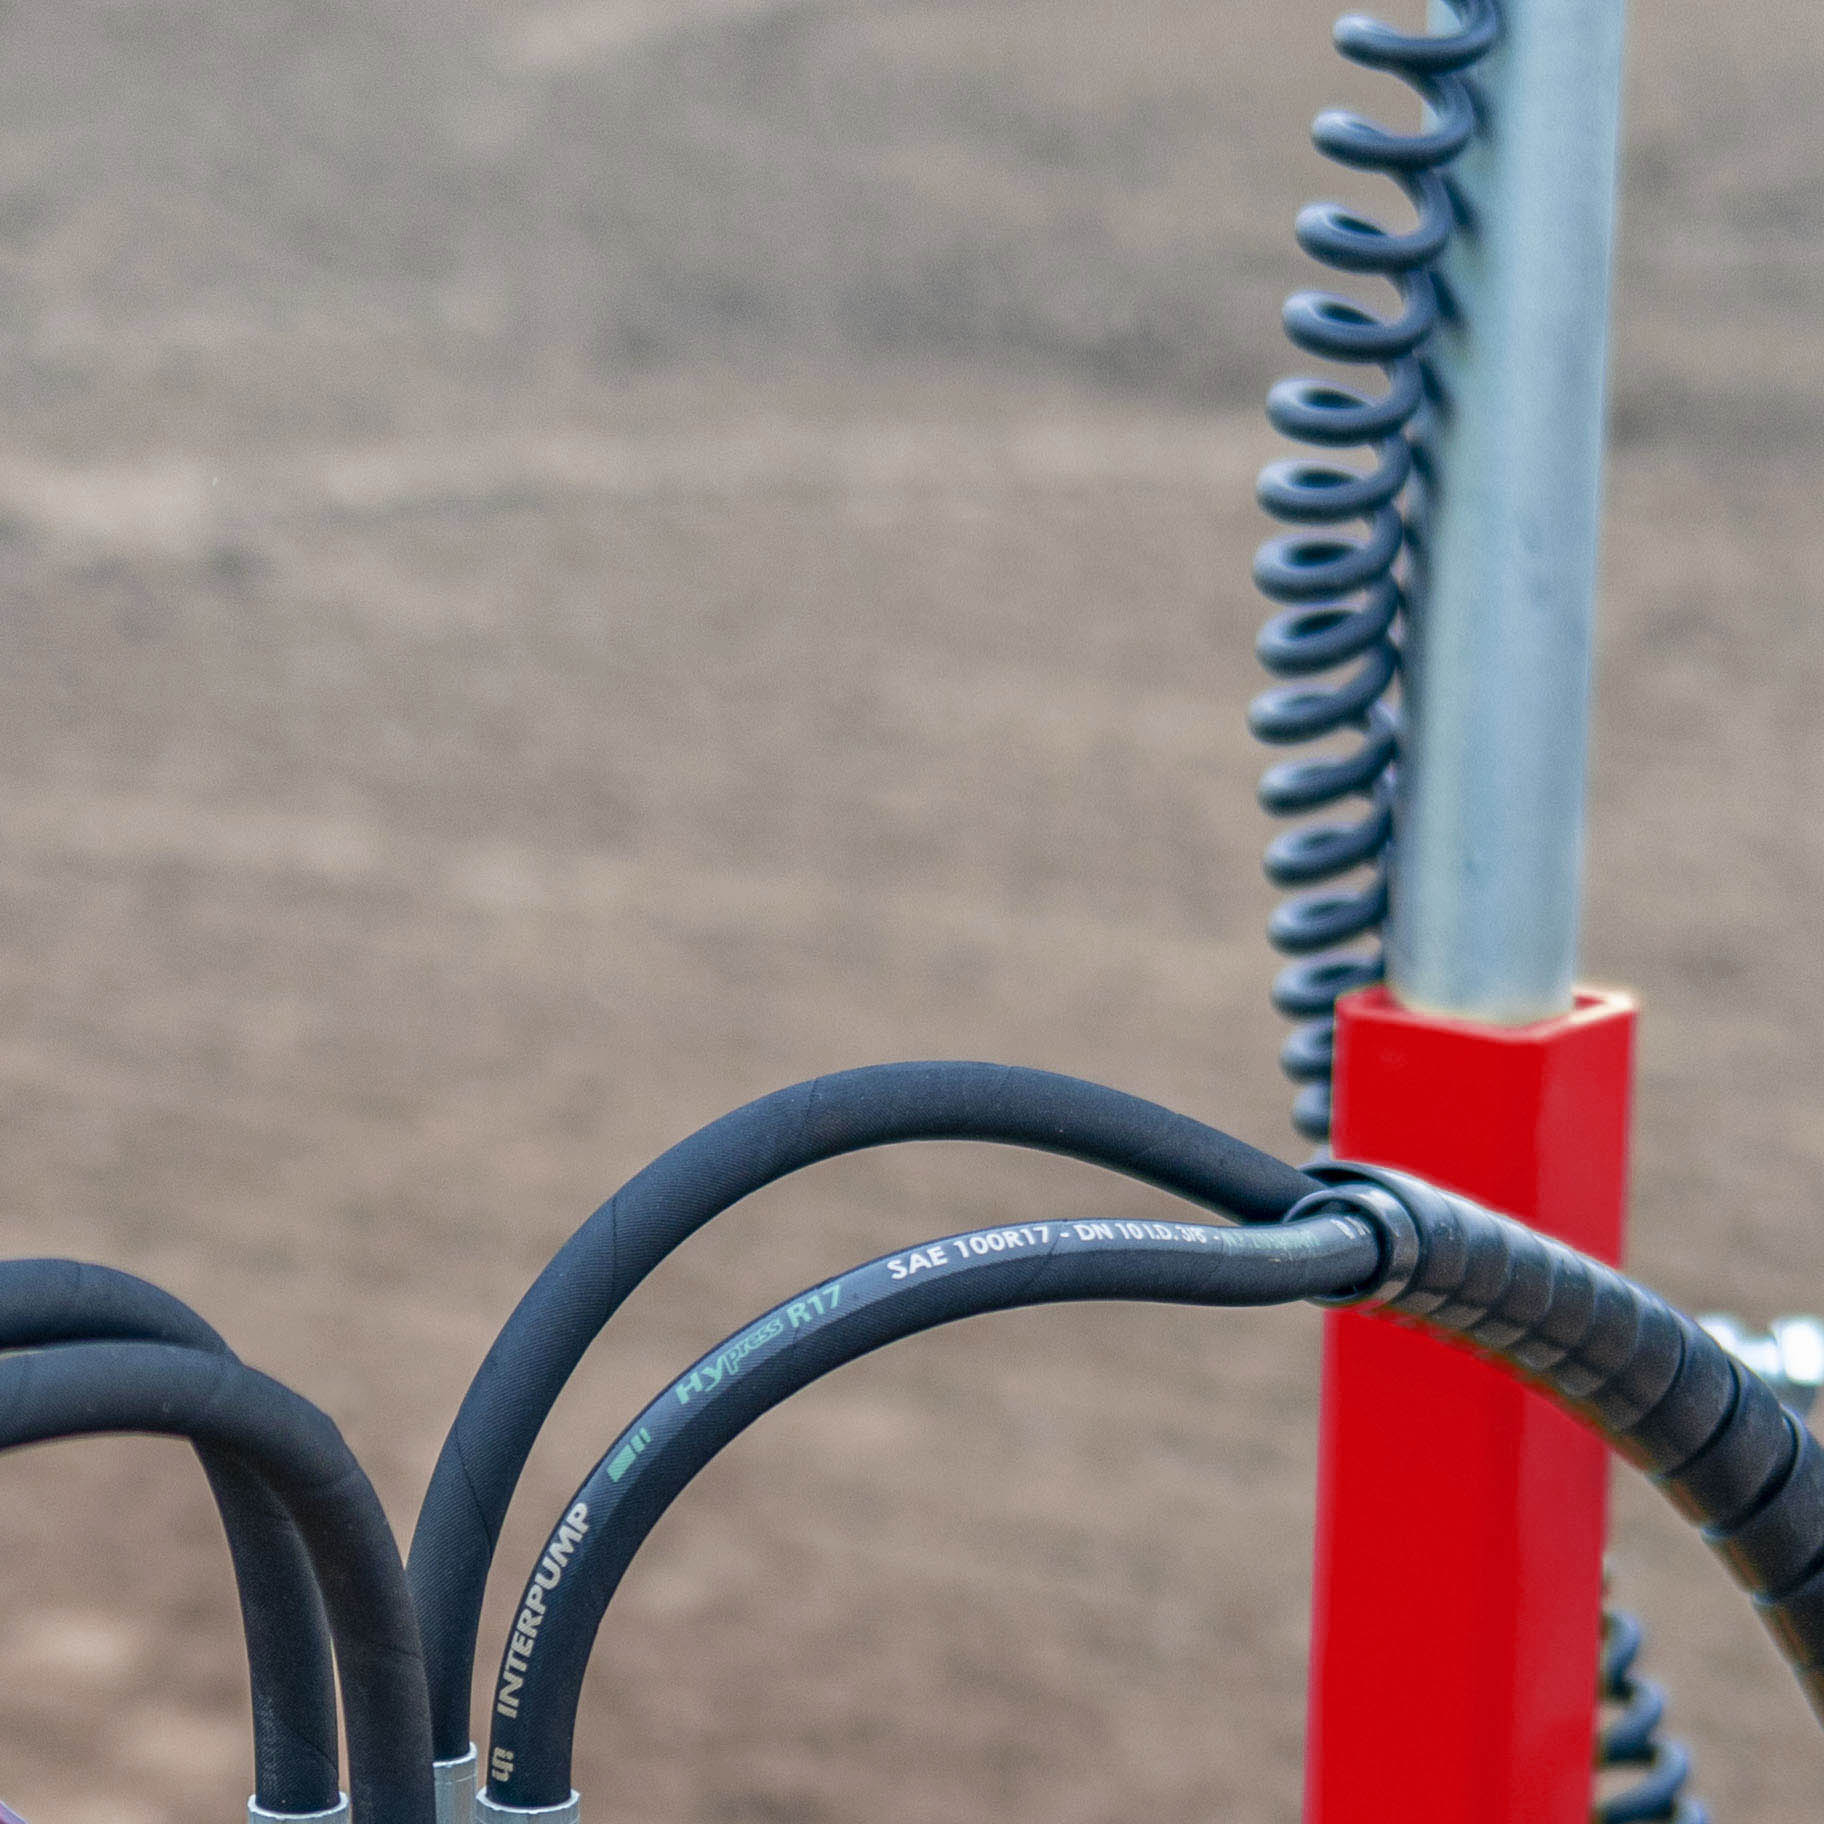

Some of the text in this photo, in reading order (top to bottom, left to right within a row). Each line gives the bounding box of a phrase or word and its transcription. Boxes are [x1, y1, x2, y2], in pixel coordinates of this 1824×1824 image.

[496, 1502, 589, 1719] INTERPUMP
[787, 1284, 840, 1328] R17
[886, 1245, 949, 1280] SAE
[953, 1225, 1050, 1258] 100R17
[1073, 1223, 1114, 1242] DN
[1115, 1222, 1138, 1240] 10
